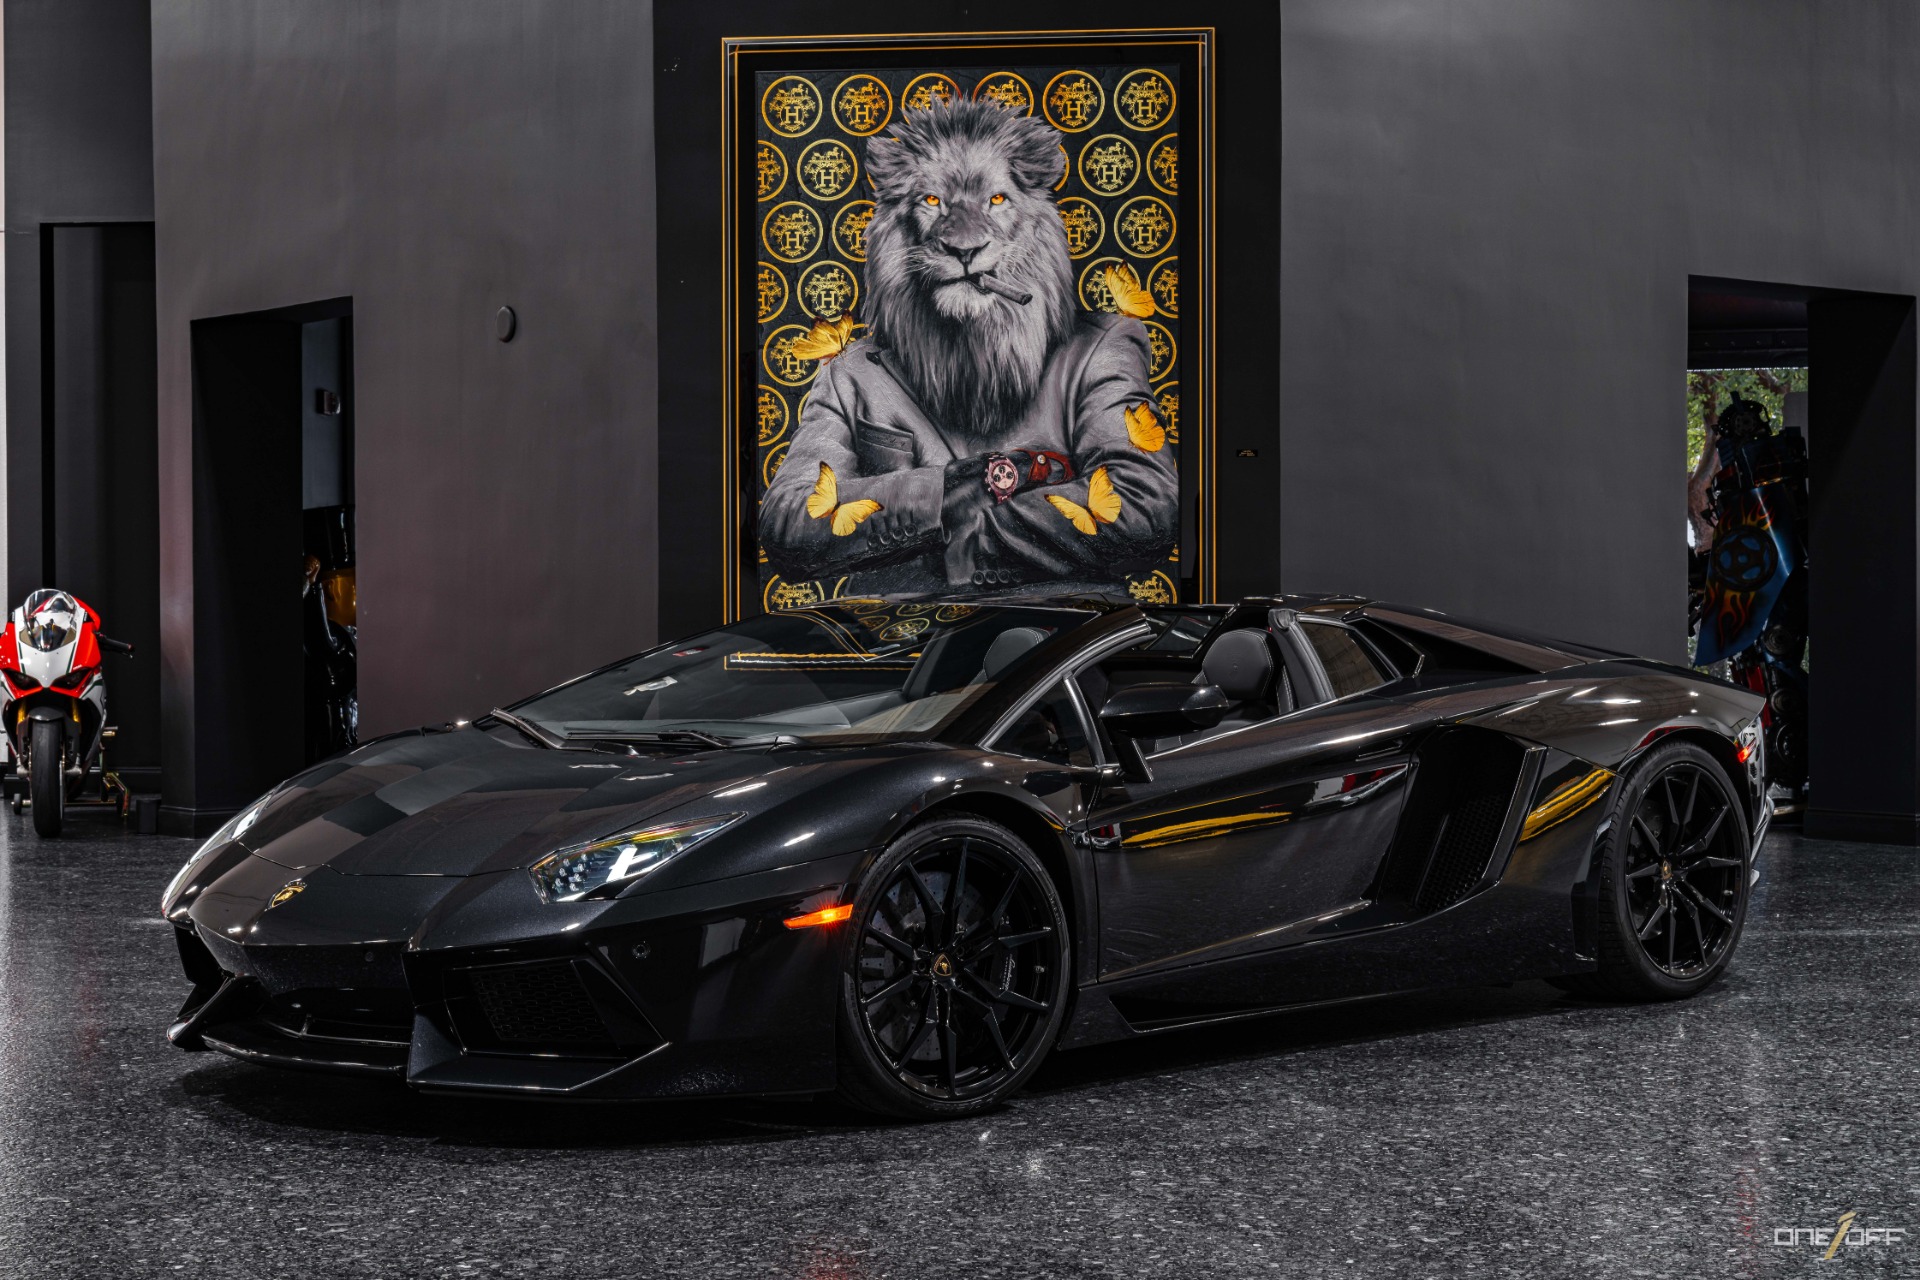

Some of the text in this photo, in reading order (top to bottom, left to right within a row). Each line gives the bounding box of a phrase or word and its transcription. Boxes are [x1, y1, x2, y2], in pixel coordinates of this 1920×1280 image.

[784, 106, 801, 123] H
[854, 105, 870, 122] H
[1066, 101, 1082, 118] H
[1137, 99, 1153, 117] H
[819, 169, 836, 187] H
[1101, 164, 1118, 182] H
[785, 231, 801, 249] H
[1067, 227, 1083, 245] H
[1137, 226, 1153, 244] H
[820, 291, 837, 309] H
